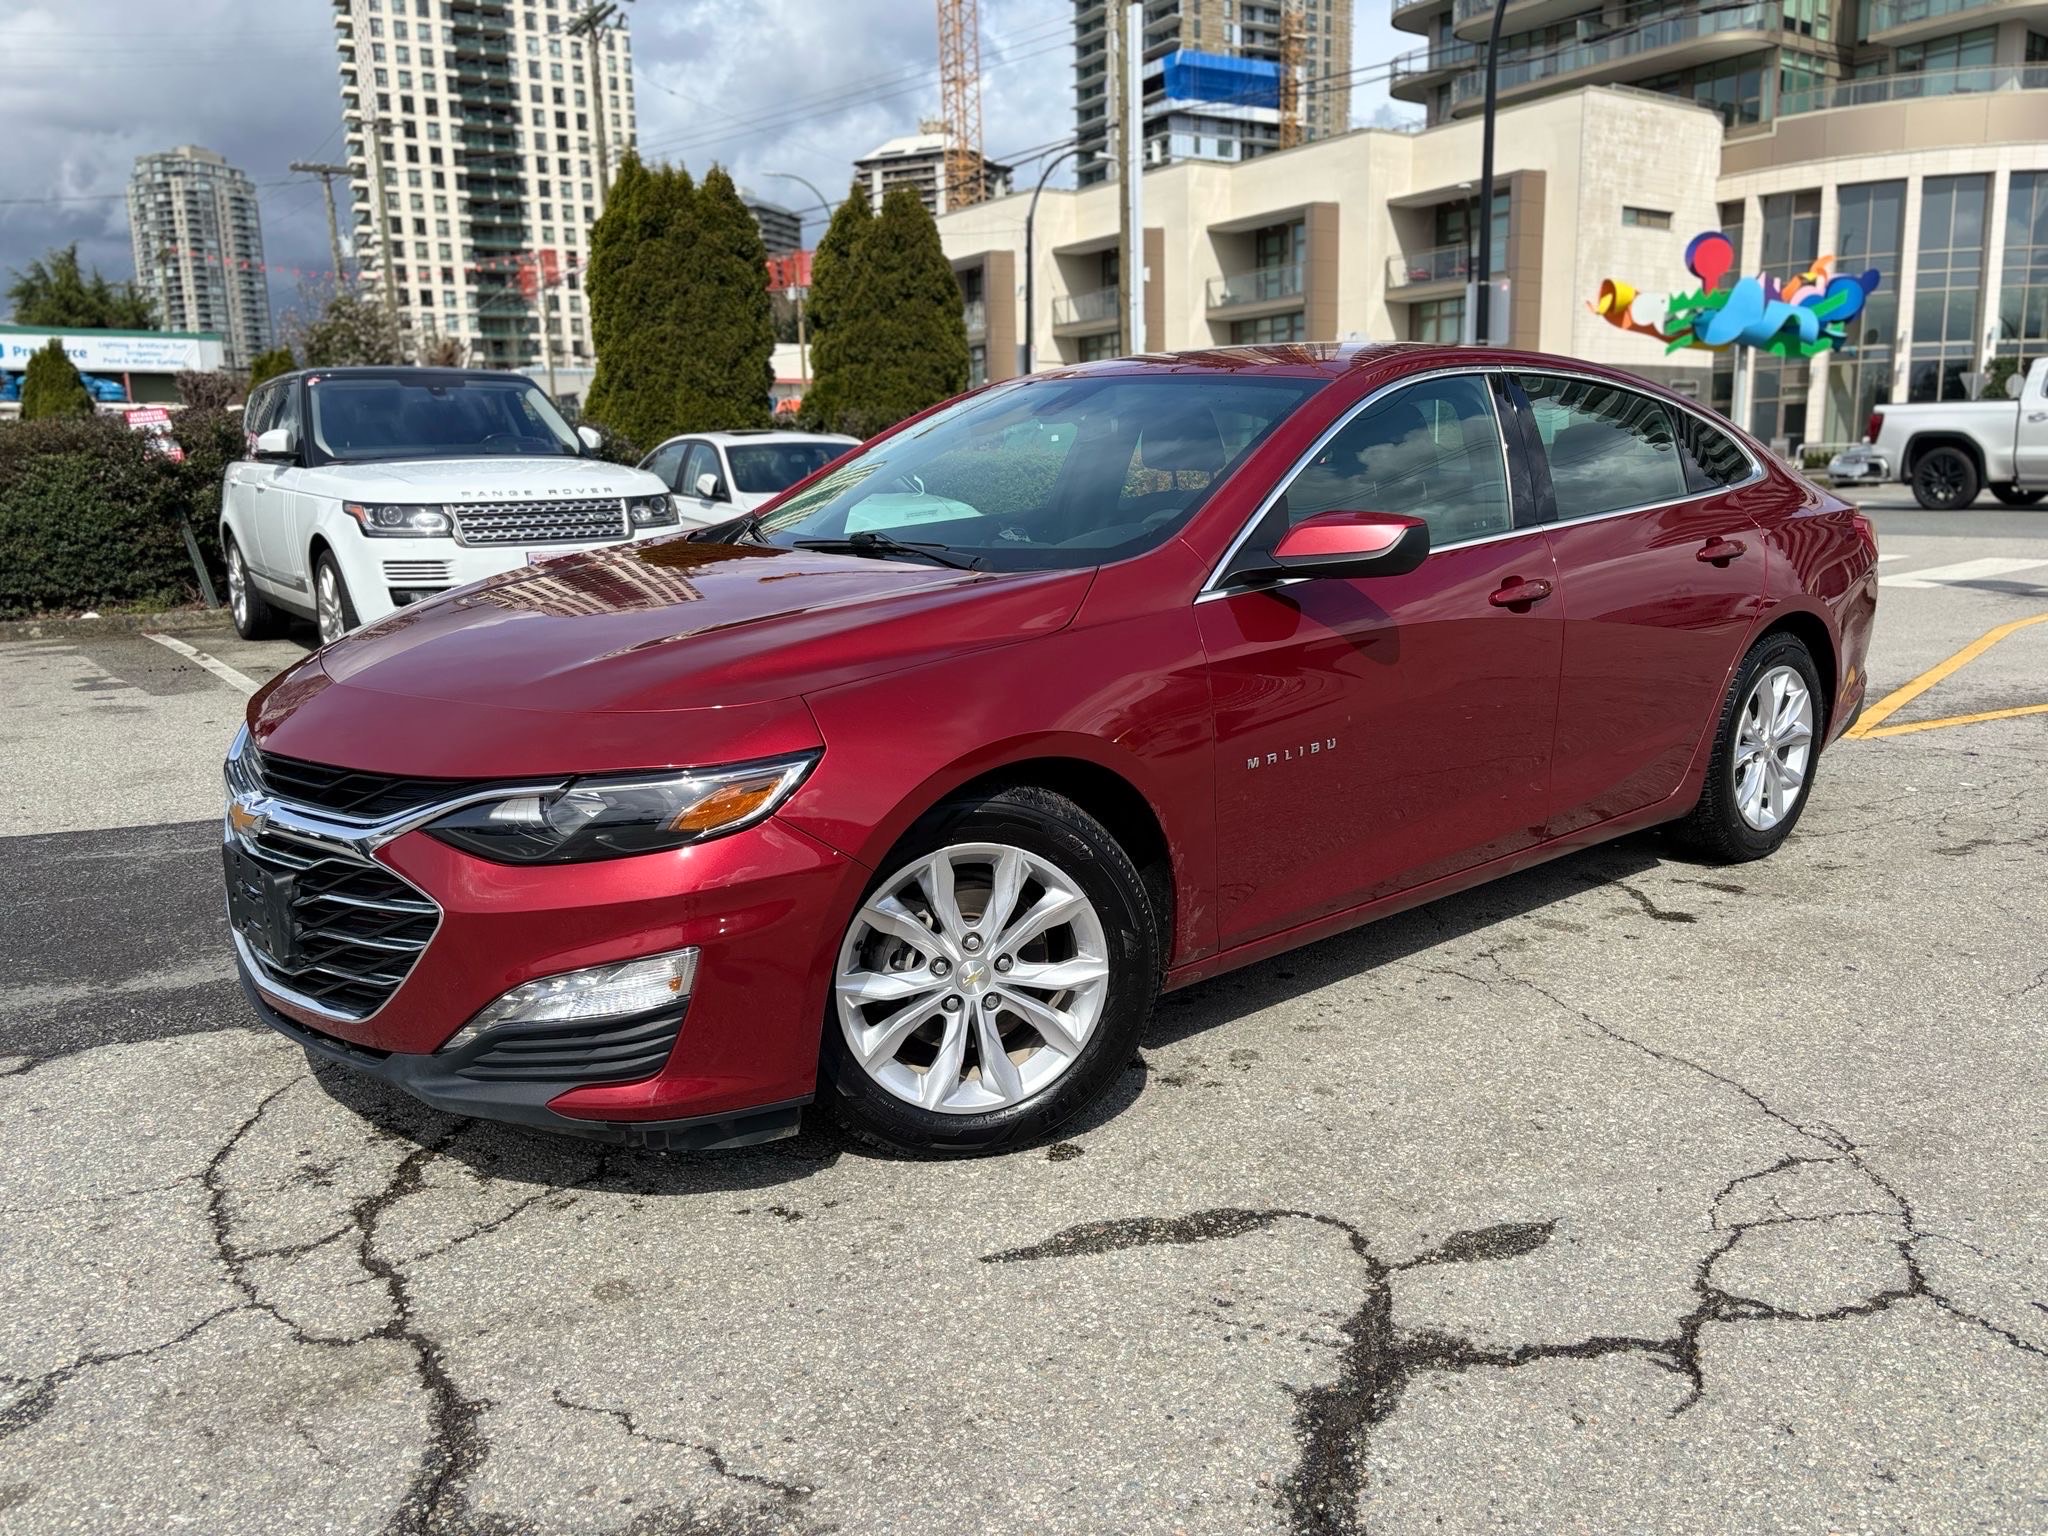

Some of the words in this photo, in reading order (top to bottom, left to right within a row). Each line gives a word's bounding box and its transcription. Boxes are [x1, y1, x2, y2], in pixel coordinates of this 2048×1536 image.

[461, 490, 533, 498] RANGE
[548, 486, 613, 495] ROVER
[1247, 738, 1337, 770] MALIBU
